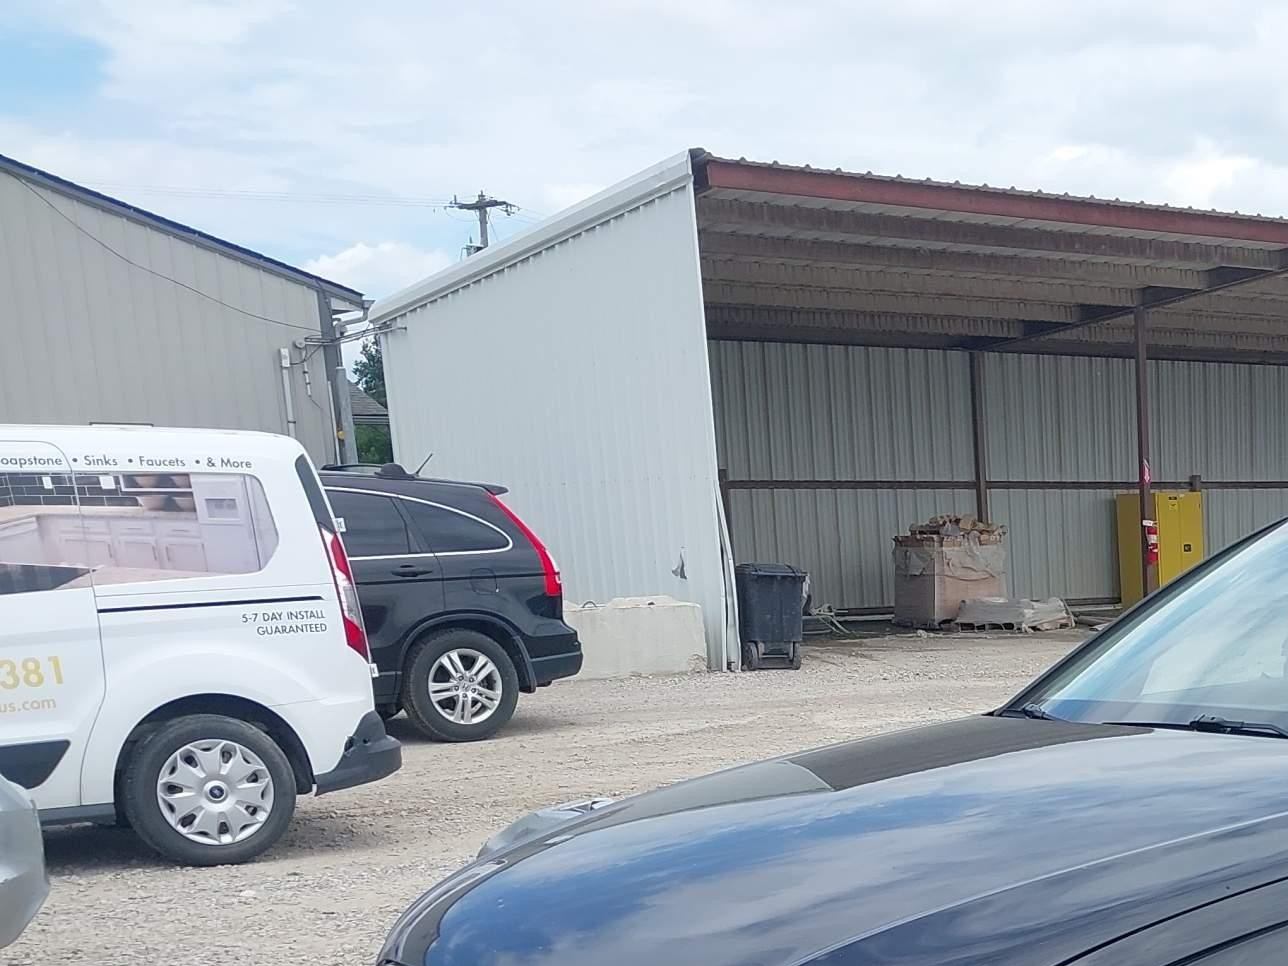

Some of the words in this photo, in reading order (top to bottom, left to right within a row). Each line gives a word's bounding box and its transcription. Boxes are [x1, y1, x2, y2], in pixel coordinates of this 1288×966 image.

[0, 456, 63, 468] oapstone
[83, 454, 119, 466] Sinks
[138, 455, 187, 467] Faucets
[206, 456, 217, 468] &
[220, 457, 253, 469] More
[241, 613, 259, 624] 5-7
[262, 611, 283, 622] DAY
[286, 609, 327, 621] INSTALL
[256, 623, 328, 636] GUARANTEED
